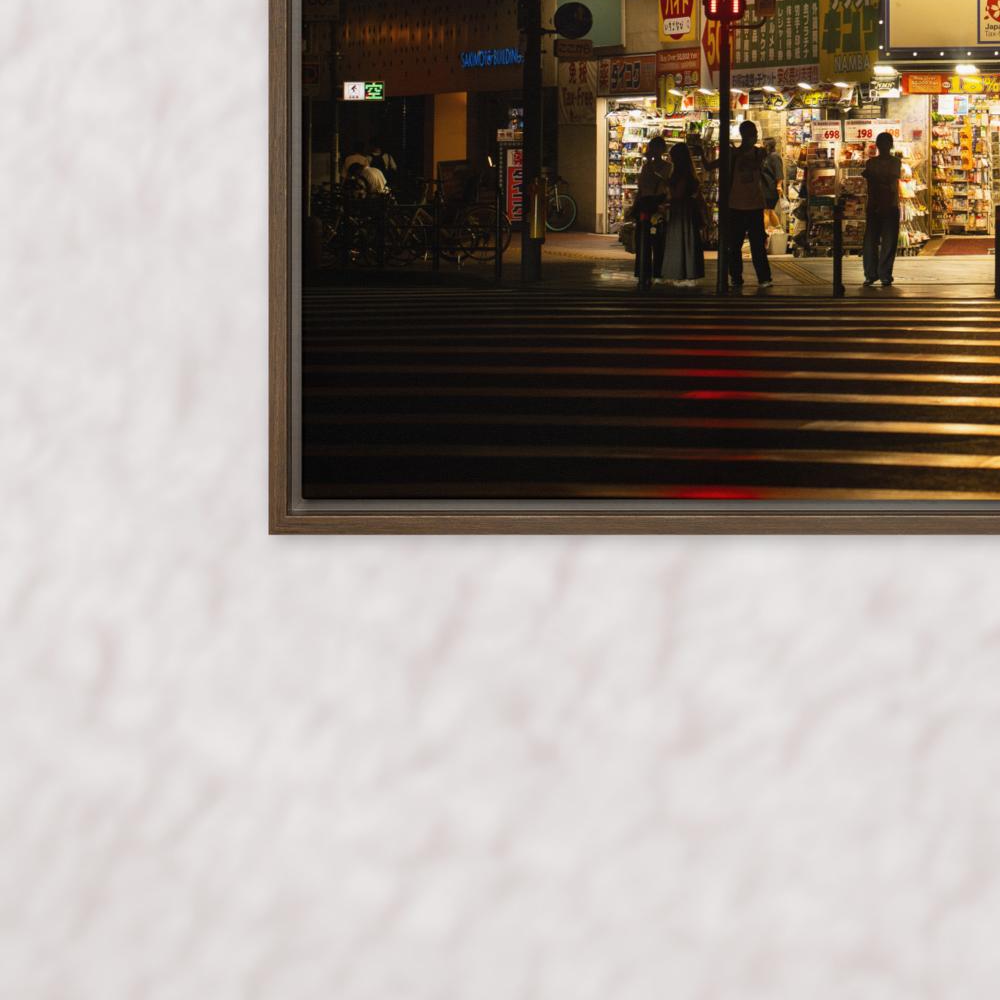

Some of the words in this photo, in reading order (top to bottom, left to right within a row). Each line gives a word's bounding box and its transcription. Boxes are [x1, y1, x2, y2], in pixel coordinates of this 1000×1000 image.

[834, 54, 871, 74] NAMBA
[364, 82, 384, 100] 空
[824, 130, 840, 140] 698
[856, 128, 873, 139] 198
